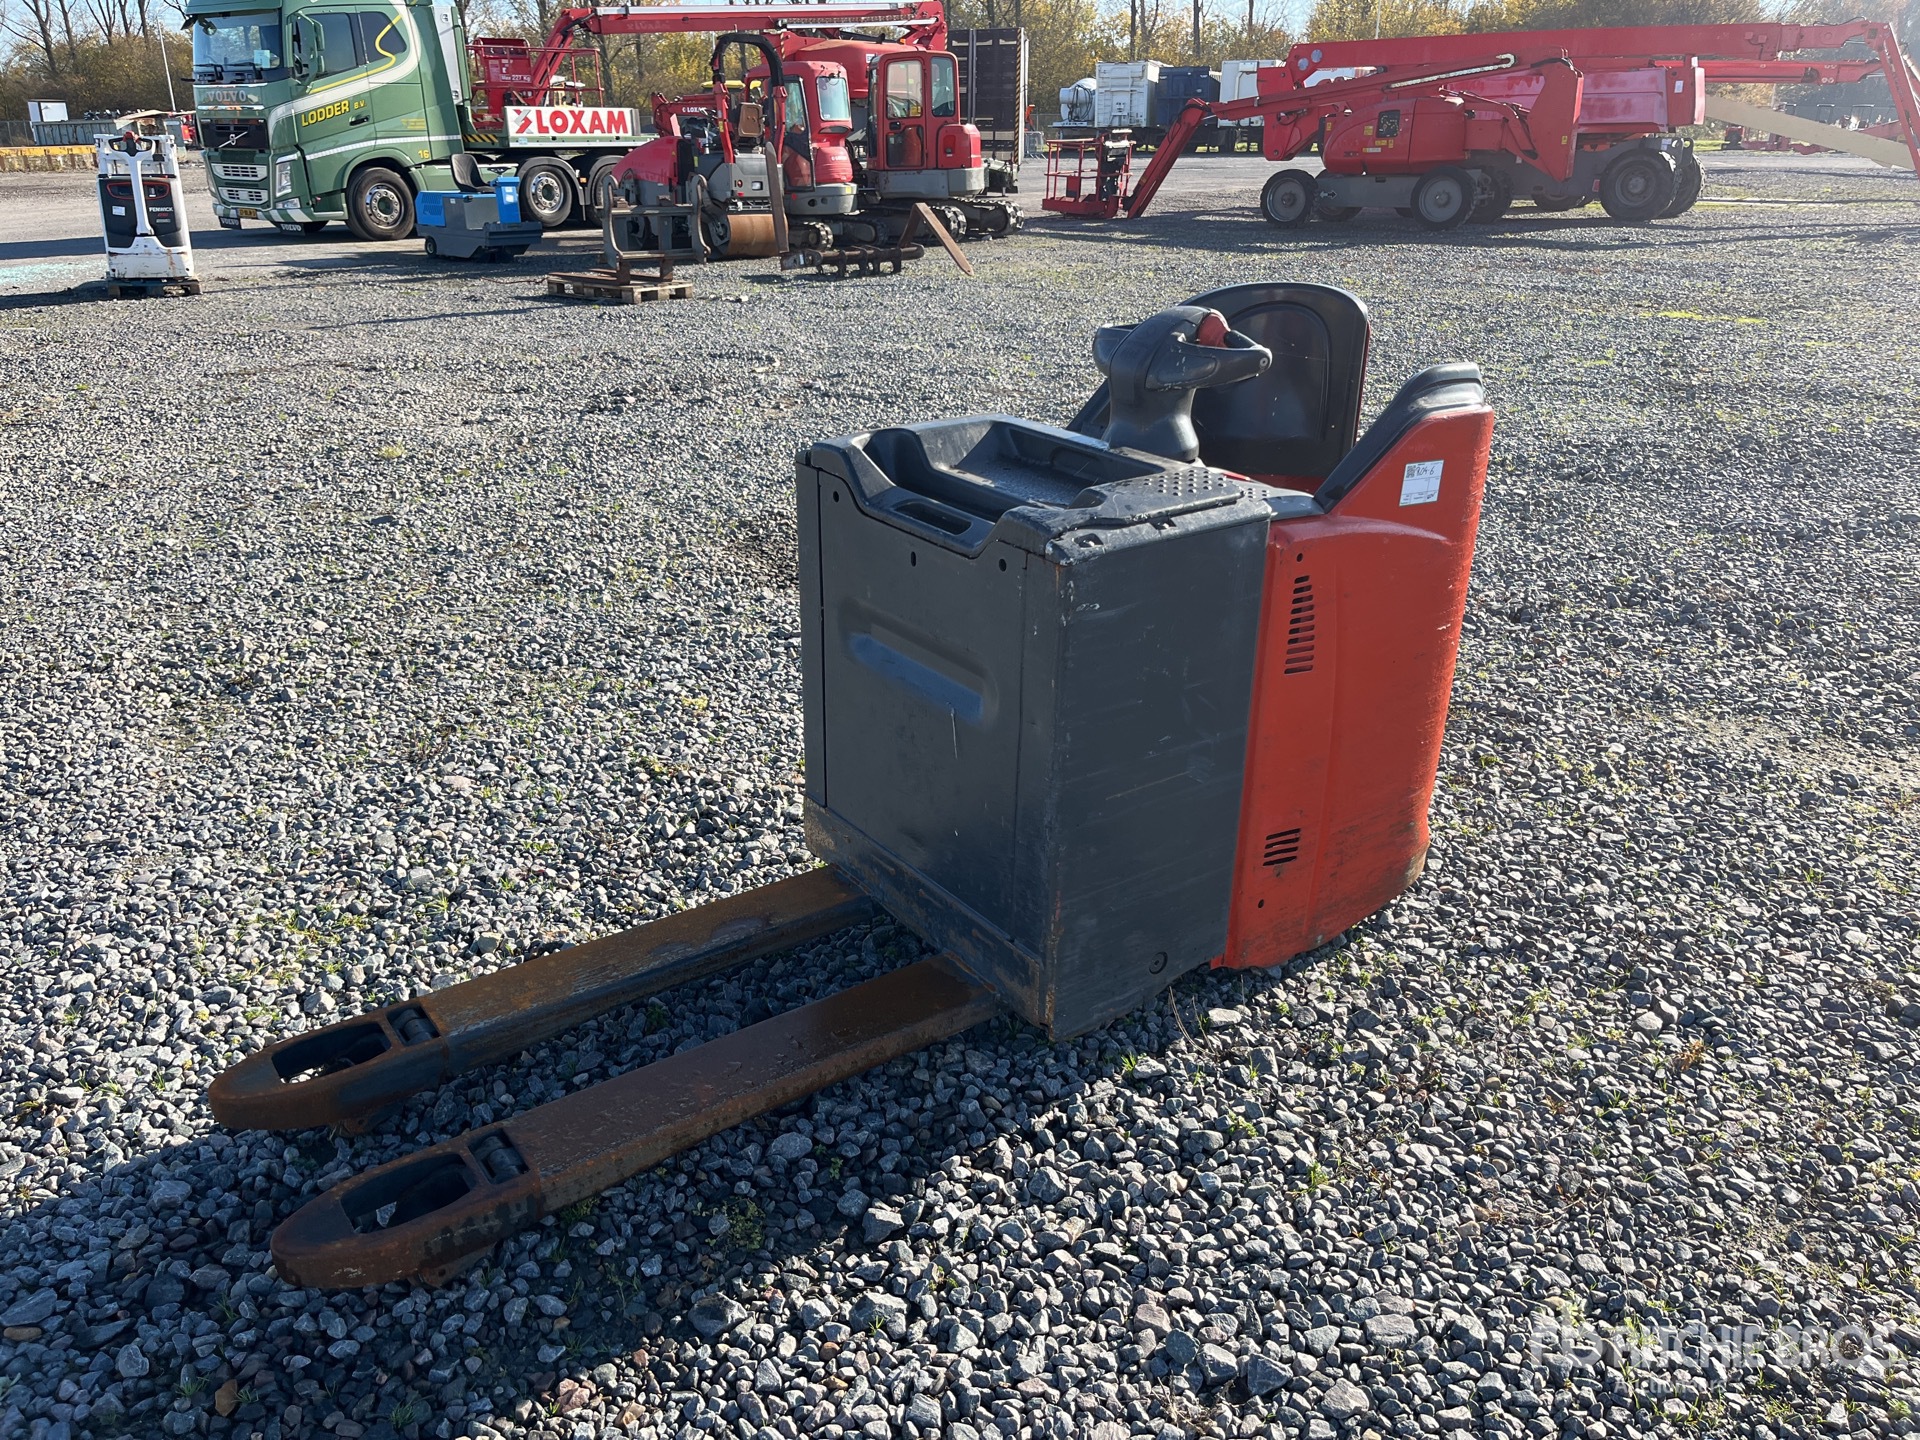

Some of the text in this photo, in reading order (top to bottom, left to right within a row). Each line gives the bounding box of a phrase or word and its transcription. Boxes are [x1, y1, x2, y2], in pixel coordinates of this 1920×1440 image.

[206, 90, 247, 102] VOLVO
[301, 100, 350, 127] LODDER
[535, 109, 629, 134] LOXAM
[418, 149, 430, 159] 16
[220, 217, 239, 226] VOLVO
[280, 223, 302, 232] VOLVO
